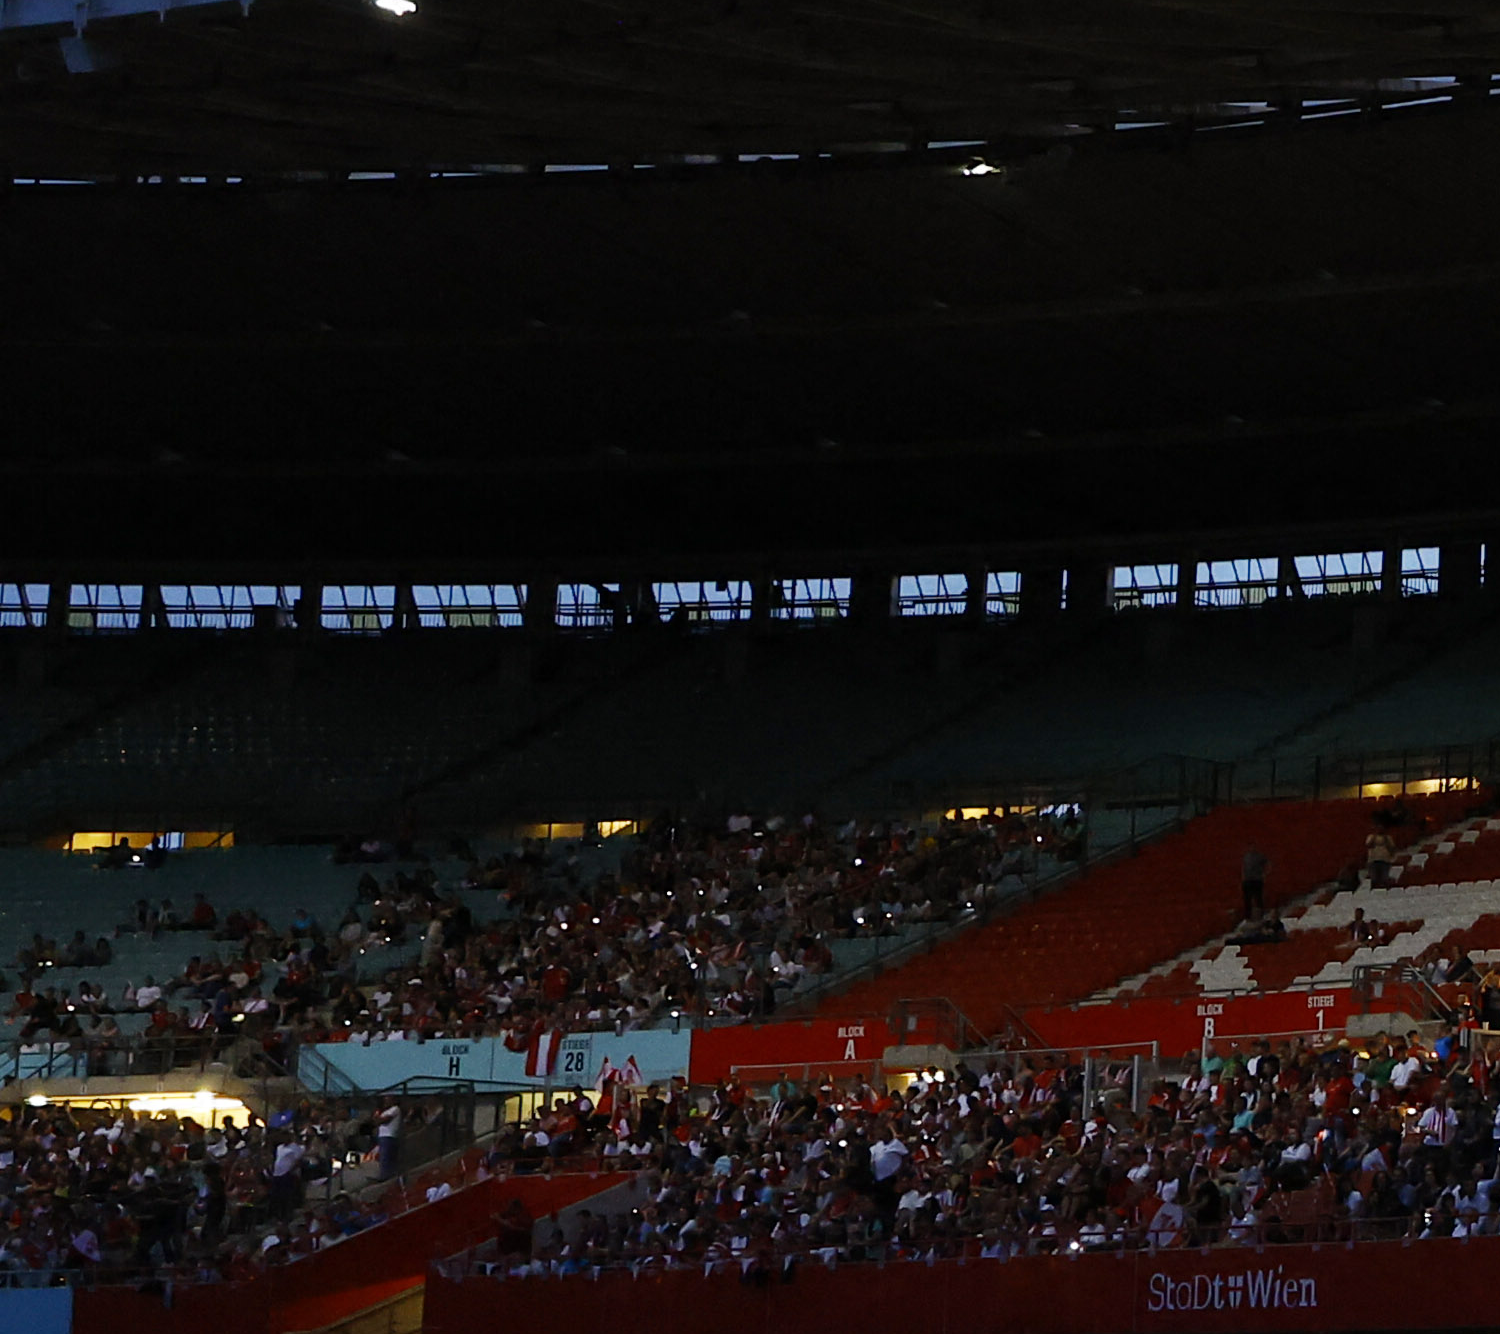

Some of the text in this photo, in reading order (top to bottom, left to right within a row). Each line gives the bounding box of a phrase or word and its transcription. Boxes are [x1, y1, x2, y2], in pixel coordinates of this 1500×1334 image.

[1196, 995, 1335, 1017] BLOCK STIEGE
[837, 1026, 865, 1038] BLOCK
[1204, 1009, 1325, 1038] B 1
[442, 1044, 469, 1055] BLOCK
[844, 1039, 856, 1060] A
[449, 1052, 584, 1076] H 28
[1247, 1264, 1318, 1310] Wien
